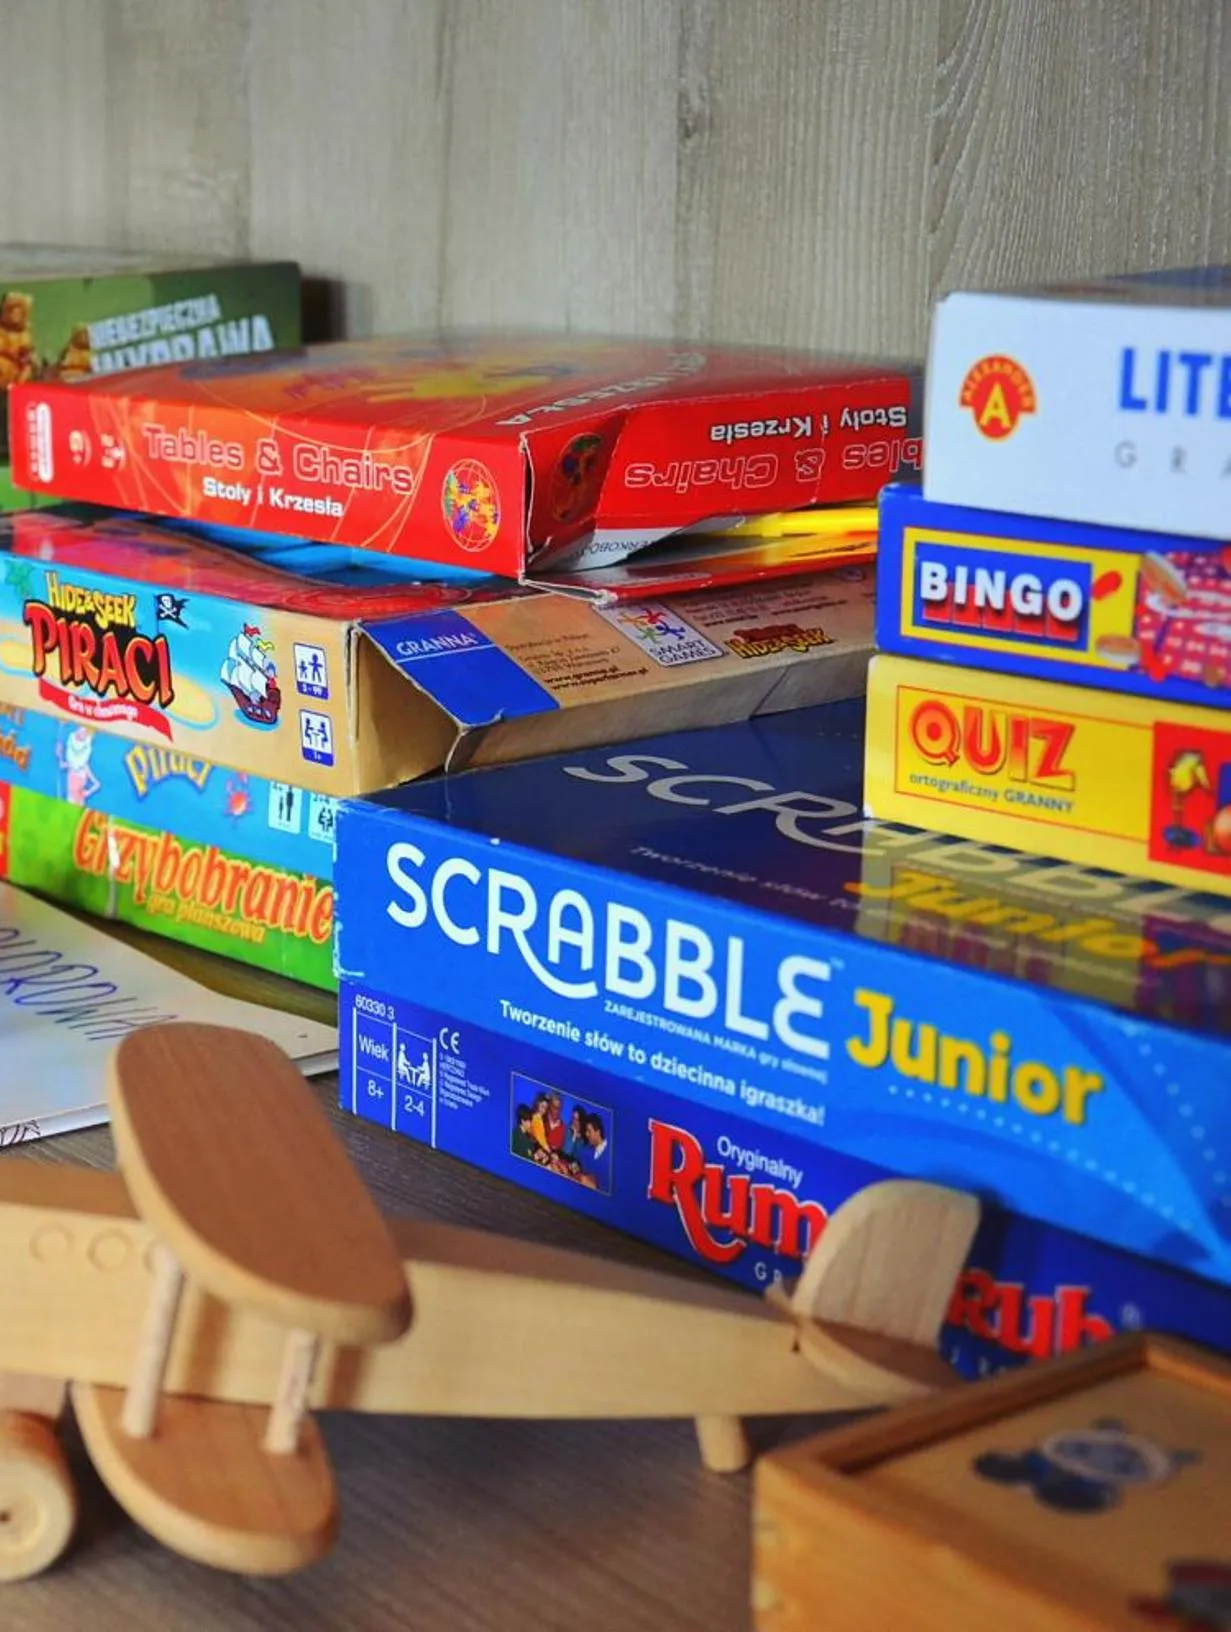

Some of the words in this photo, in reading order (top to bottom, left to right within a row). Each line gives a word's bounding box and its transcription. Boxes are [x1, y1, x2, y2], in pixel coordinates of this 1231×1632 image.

[142, 422, 244, 470] Tables
[255, 438, 284, 477] &
[293, 445, 416, 496] Chairs
[920, 561, 1083, 622] BINGO
[24, 601, 175, 708] PIRACI
[396, 633, 474, 658] GRANNA
[909, 699, 1076, 793] QUIZ
[909, 772, 1000, 802] ortograficzny
[1004, 788, 1075, 813] GRANNY
[74, 808, 334, 944] Grzybobranie
[386, 842, 832, 1060] SCRABBLE
[388, 1005, 396, 1020] 3
[358, 1034, 390, 1062] Wiek
[500, 999, 581, 1042] Tworzenie
[584, 1029, 624, 1057] słów
[627, 1043, 647, 1064] to
[650, 1052, 736, 1096] dziecinna
[740, 1079, 826, 1127] igraszka!
[845, 988, 1106, 1125] Junior
[367, 1079, 385, 1099] 8+
[403, 1094, 426, 1117] 2-4
[717, 1135, 804, 1186] Oryginalny
